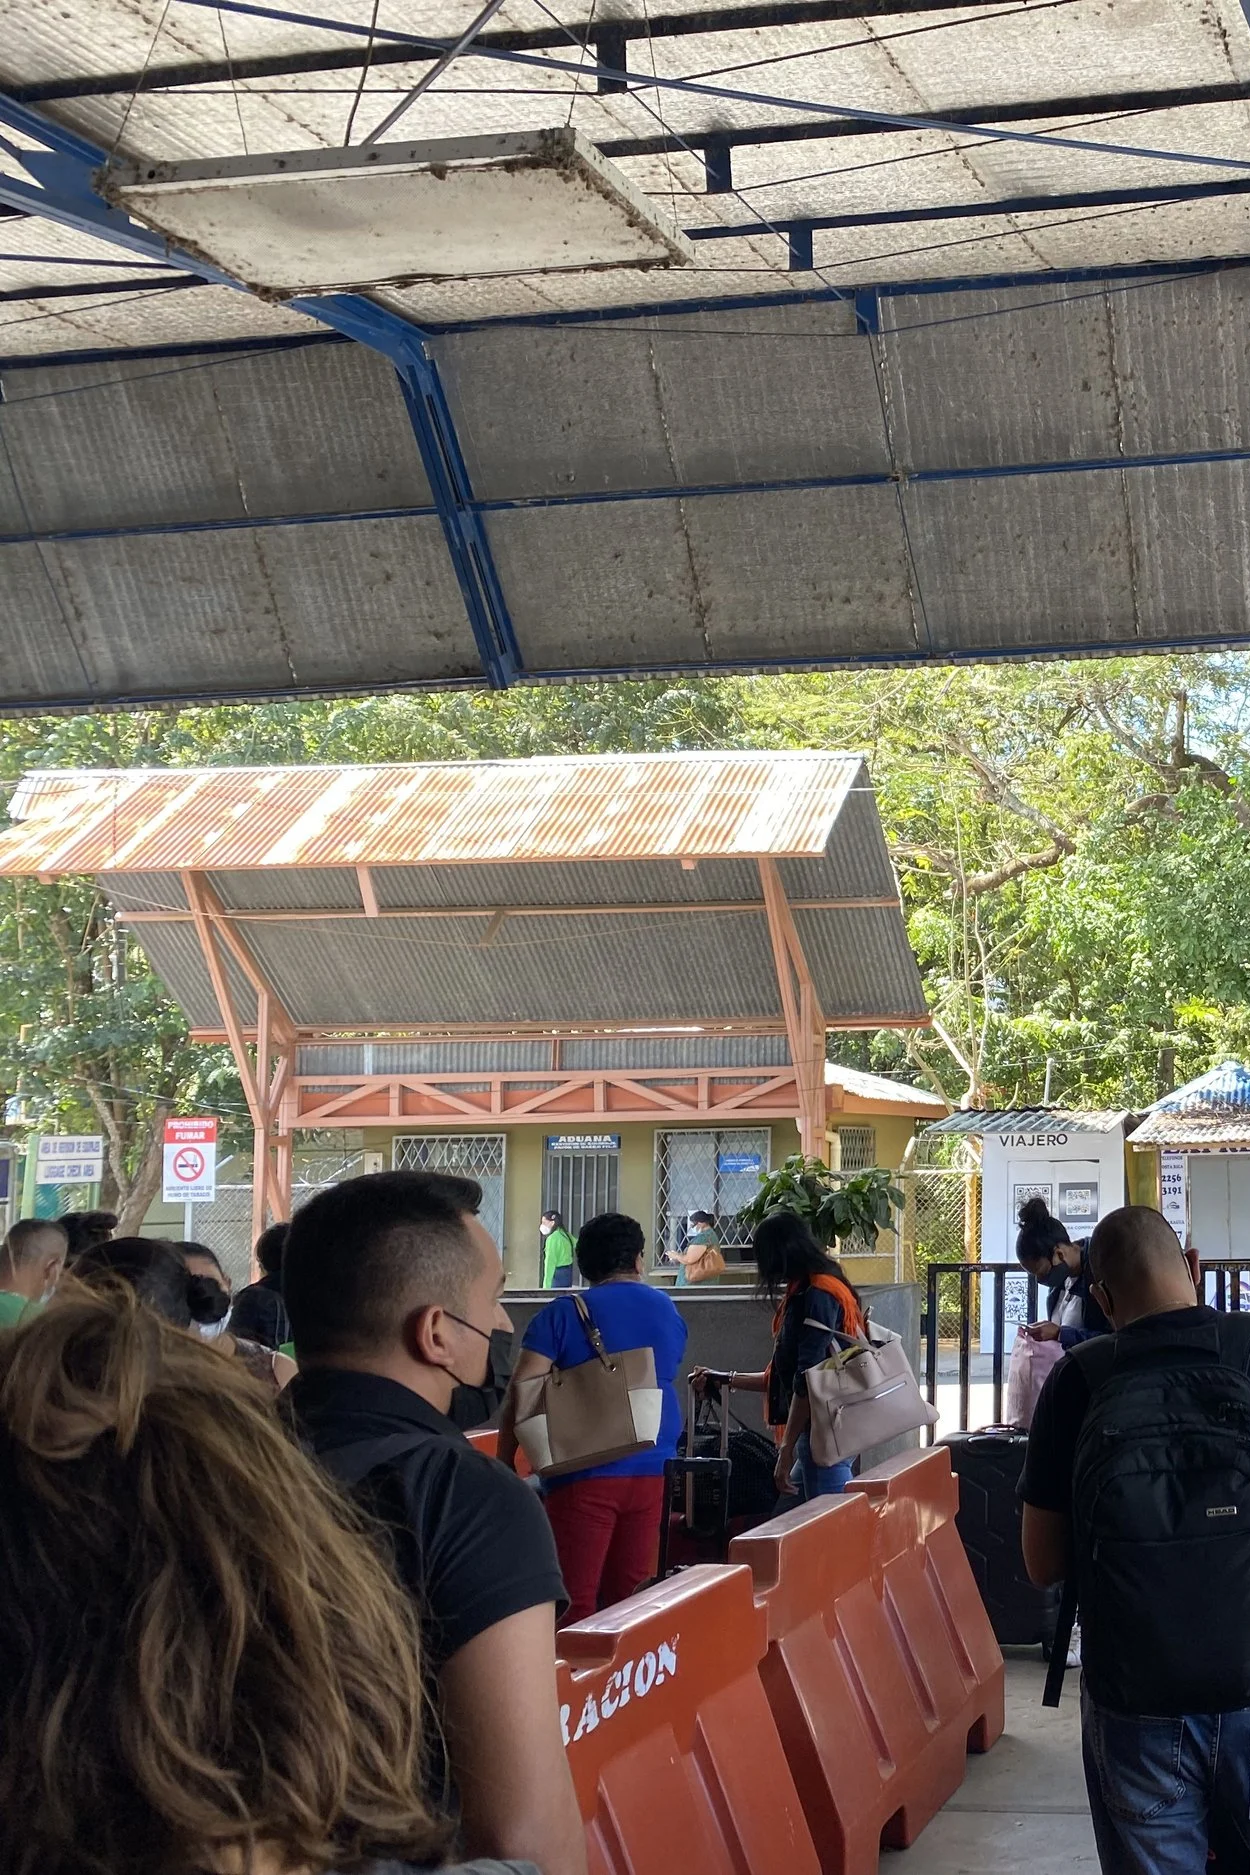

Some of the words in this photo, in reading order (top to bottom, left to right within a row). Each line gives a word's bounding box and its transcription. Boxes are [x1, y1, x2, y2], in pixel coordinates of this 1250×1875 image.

[168, 1121, 214, 1129] PROHIBIDO
[175, 1131, 205, 1140] FUMAR
[999, 1133, 1068, 1146] VIAJERO
[1162, 1174, 1182, 1183] 2256
[1162, 1187, 1182, 1195] 3191
